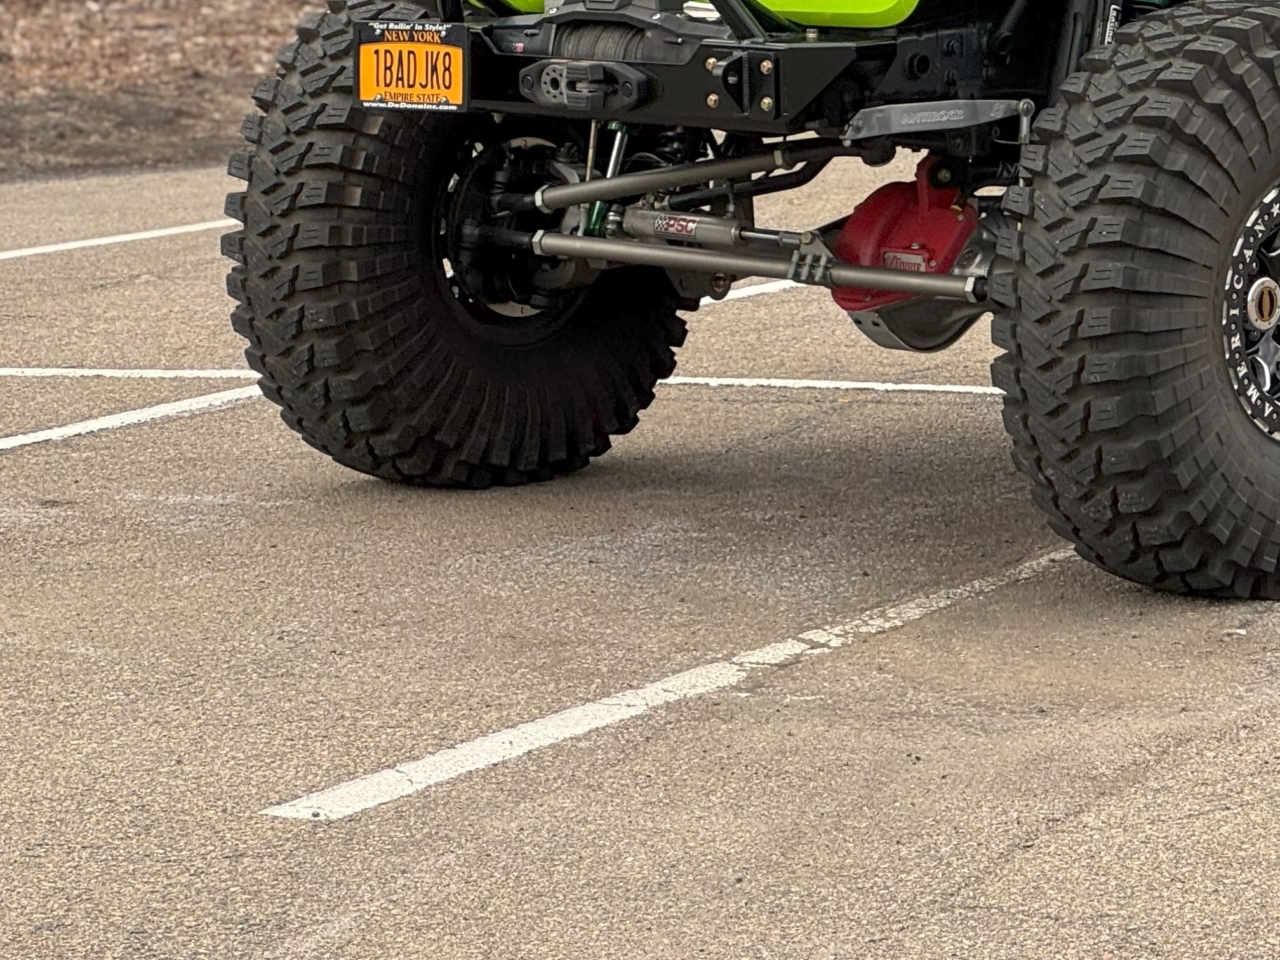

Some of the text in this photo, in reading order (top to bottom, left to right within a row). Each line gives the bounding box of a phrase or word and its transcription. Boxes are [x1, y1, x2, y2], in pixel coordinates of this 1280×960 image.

[414, 23, 423, 31] In
[384, 30, 441, 44] NEW YORK
[384, 91, 441, 103] EMPIRE STATE
[667, 216, 697, 234] PSC
[1229, 220, 1274, 417] AMERICAN
